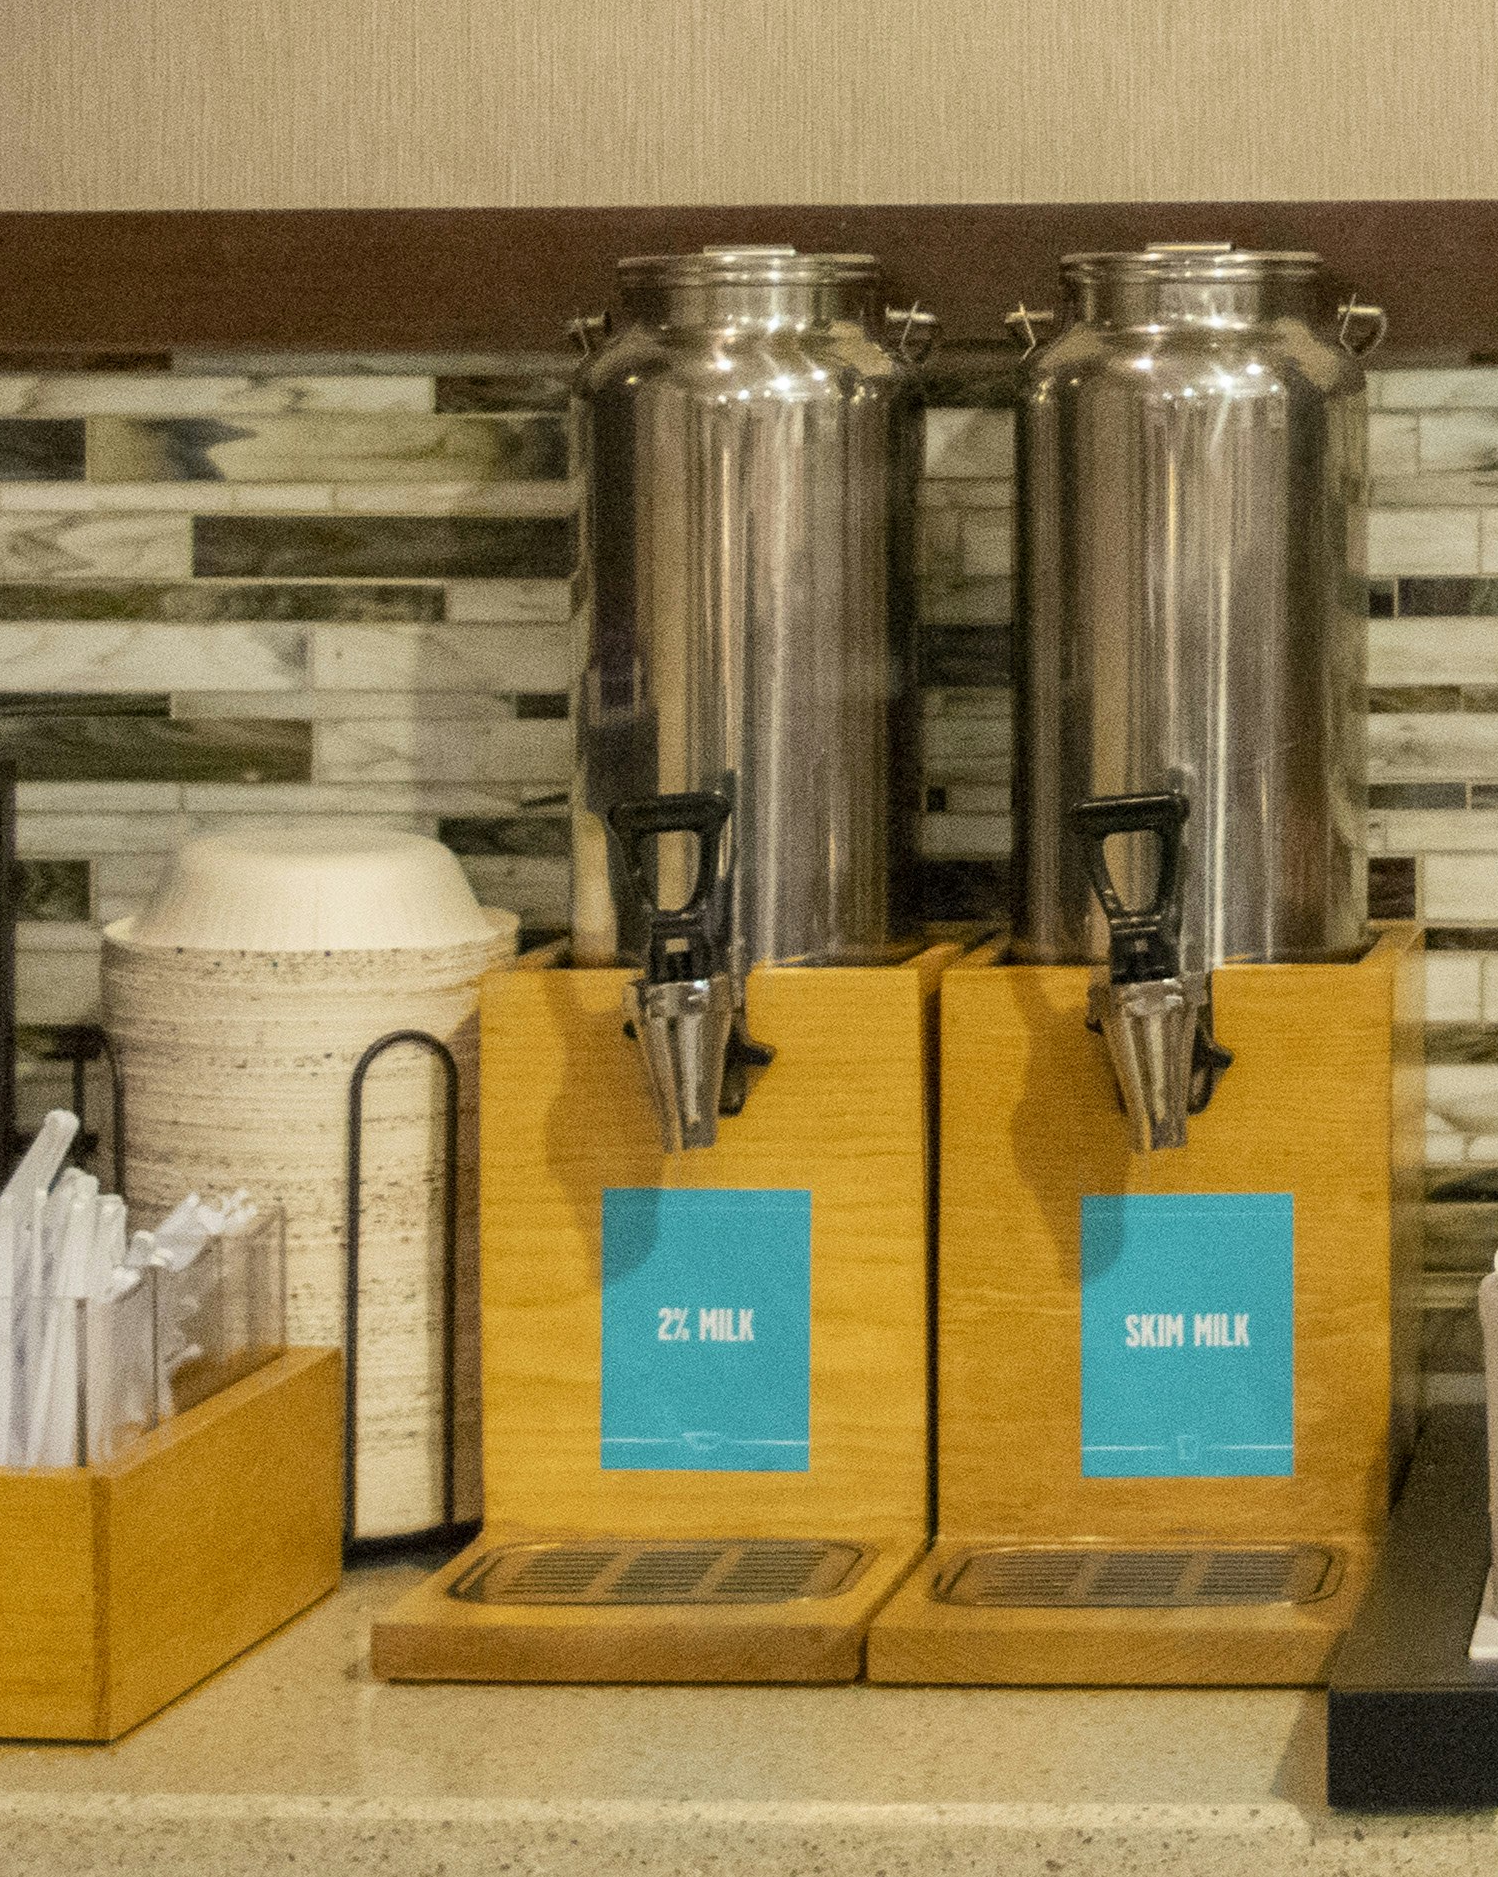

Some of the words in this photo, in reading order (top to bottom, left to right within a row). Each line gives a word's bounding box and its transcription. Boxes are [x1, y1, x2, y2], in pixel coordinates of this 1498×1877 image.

[658, 1308, 689, 1341] 2%
[699, 1308, 754, 1341] MILK
[1125, 1313, 1183, 1347] SKIM
[1194, 1313, 1250, 1347] MILK
